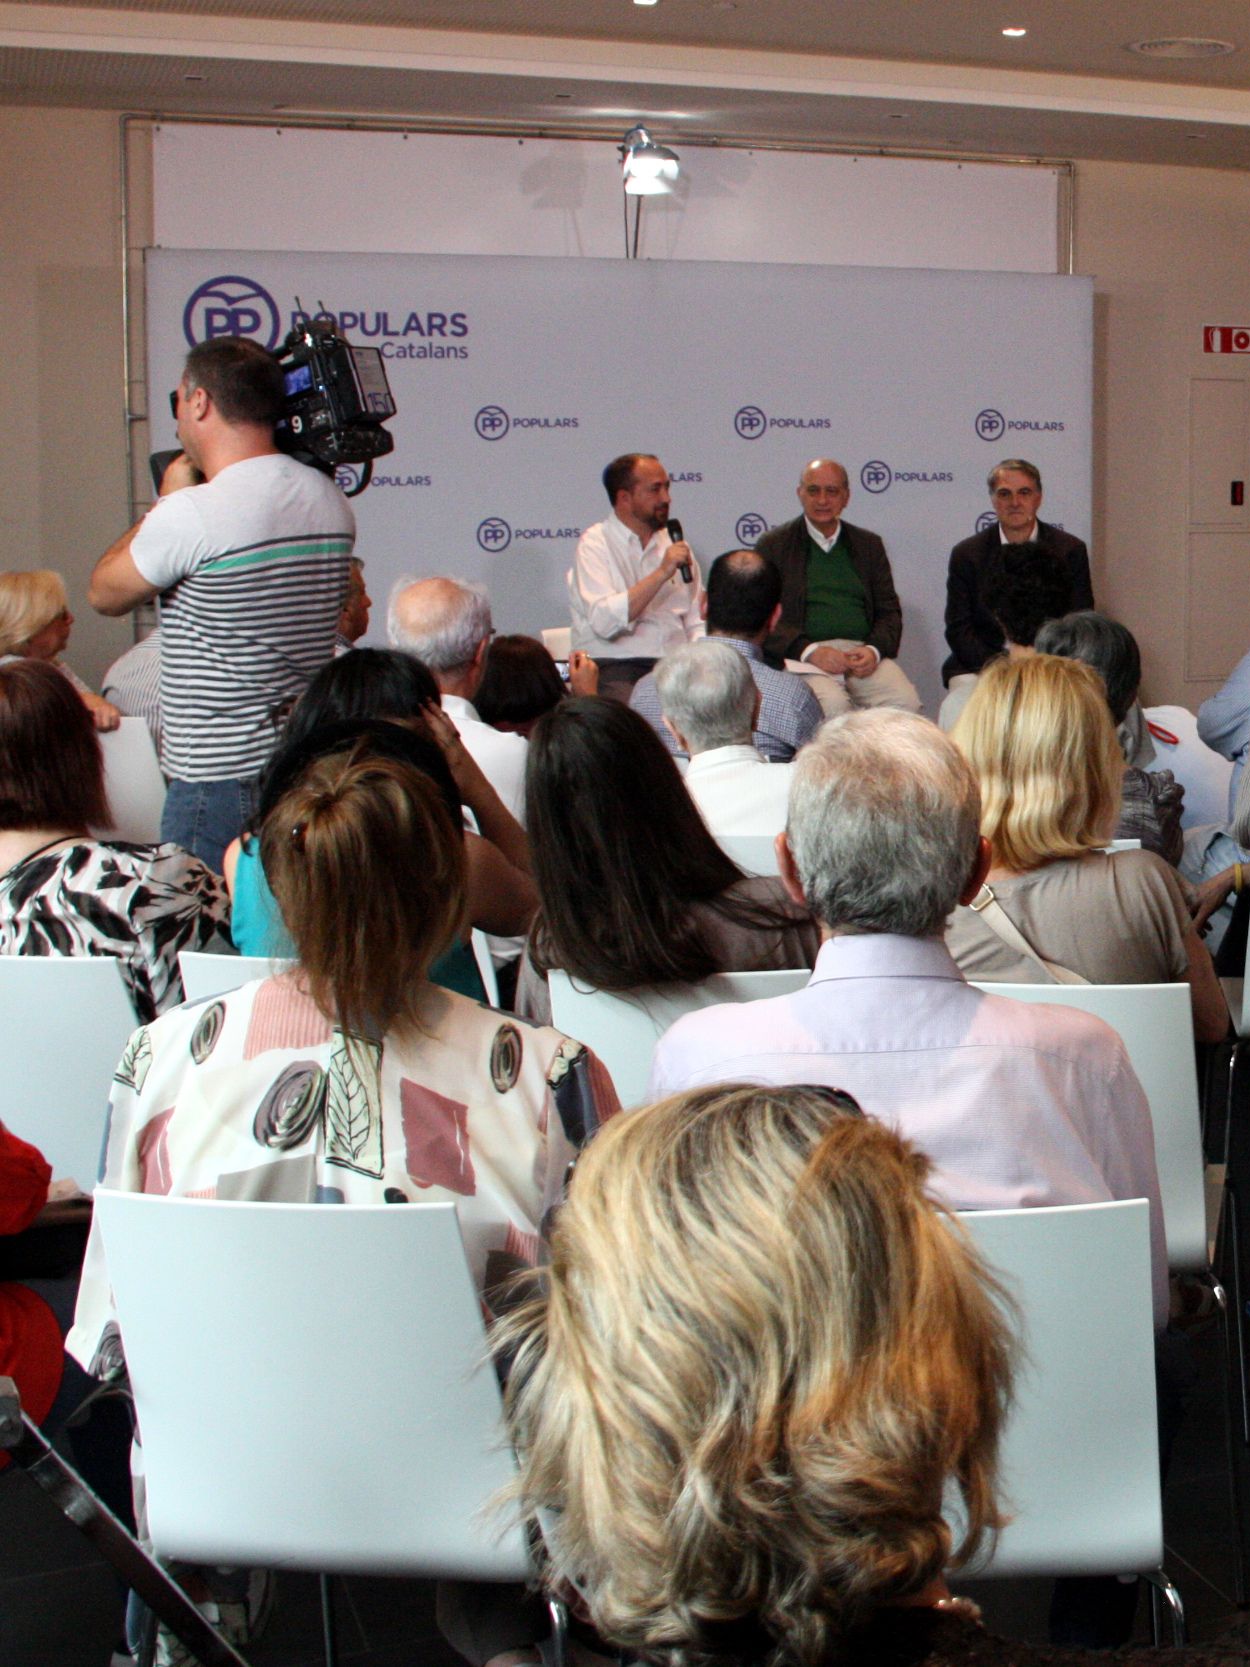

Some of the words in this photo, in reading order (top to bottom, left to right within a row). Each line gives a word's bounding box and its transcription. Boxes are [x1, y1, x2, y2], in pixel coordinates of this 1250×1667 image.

[381, 342, 469, 359] Catalans
[291, 415, 303, 433] 9
[513, 418, 579, 428] POPULARS
[769, 418, 831, 429] POPULARS
[1008, 421, 1065, 431] POPULARS
[371, 475, 432, 487] OPULARS
[894, 472, 953, 482] POPULARS
[515, 528, 581, 539] POPULARS
